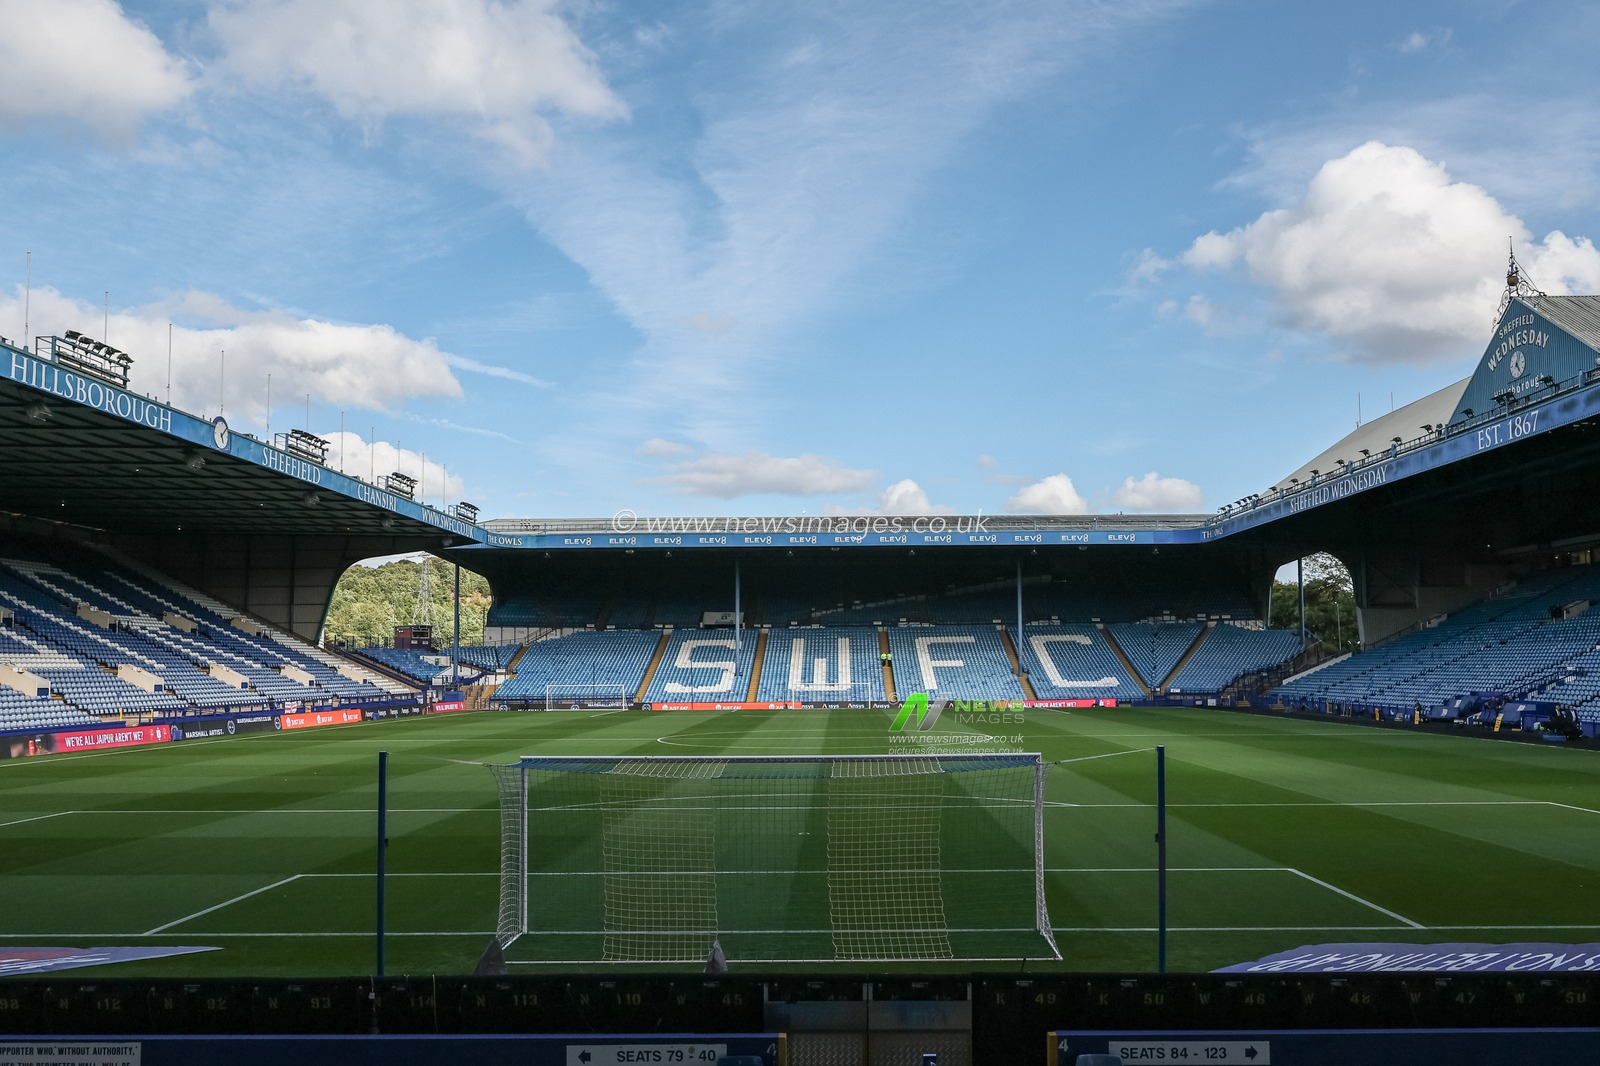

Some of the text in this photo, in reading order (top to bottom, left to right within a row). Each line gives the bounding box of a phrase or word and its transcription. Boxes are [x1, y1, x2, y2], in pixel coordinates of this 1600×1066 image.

[1499, 314, 1534, 339] SHEFFIELD
[1487, 329, 1549, 372] WEDNESDAY
[10, 352, 172, 433] HILLSBOROUGH
[1477, 410, 1540, 451] EST. 1867
[262, 447, 321, 485] SHEFFIELD
[1289, 465, 1388, 513] SHEFFIELD WEDNESDAY
[357, 484, 397, 512] CHANSIRI
[488, 534, 522, 546] THE OWLS
[564, 536, 592, 546] ELEV8
[609, 536, 637, 546] ELEV8
[654, 536, 682, 545] ELEV8
[699, 536, 727, 545] ELEV8
[744, 536, 772, 545] ELEV8
[790, 536, 817, 545] ELEV8
[880, 535, 907, 544] ELEV8
[924, 535, 952, 544] ELEV8
[969, 535, 997, 544] ELEV8
[1014, 534, 1042, 544] ELEV8
[1061, 534, 1089, 543] ELEV8
[1108, 534, 1136, 542] ELEV8
[64, 730, 144, 748] WE'RE ALL JAIPUR AREN'T WE?
[185, 730, 208, 738] MARSHALL
[1246, 952, 1349, 972] APP
[1323, 952, 1500, 972] BETTING
[1058, 1039, 1068, 1052] 4
[37, 1047, 54, 1056] WHO,
[58, 1047, 90, 1056] WITHOUT
[93, 1047, 134, 1056] AUTHORITY,
[616, 1050, 662, 1062] SEATS
[667, 1050, 684, 1062] 79
[698, 1050, 716, 1062] 40
[1120, 1047, 1166, 1059] SEATS
[1170, 1047, 1188, 1059] 84
[1204, 1047, 1227, 1059] 123
